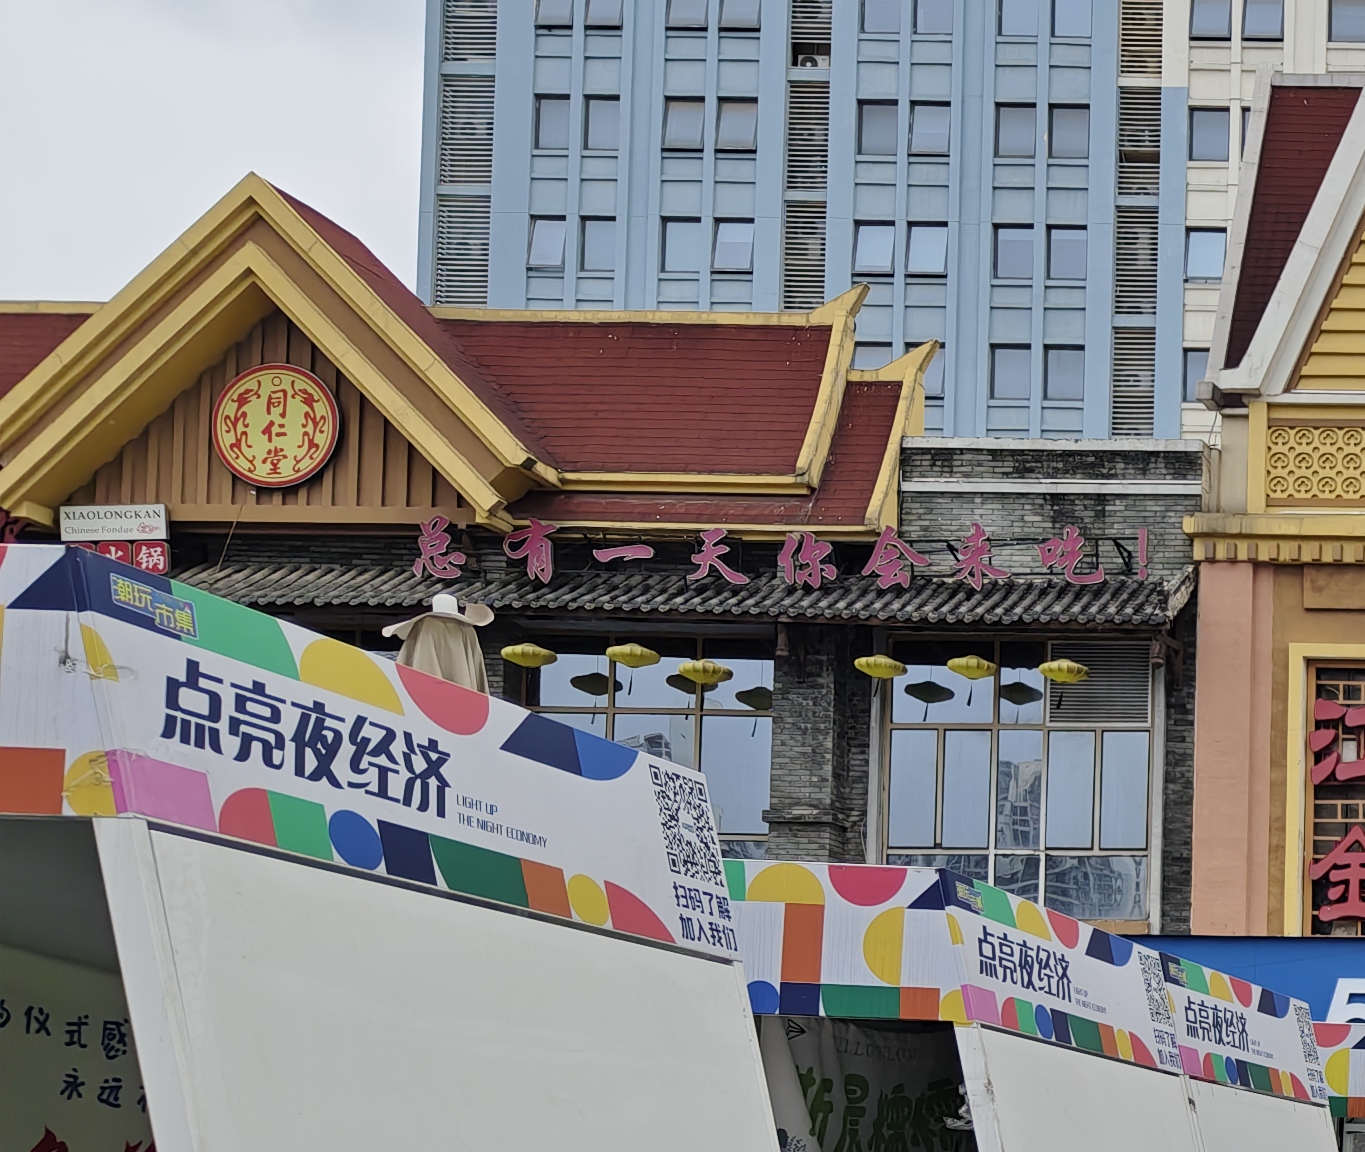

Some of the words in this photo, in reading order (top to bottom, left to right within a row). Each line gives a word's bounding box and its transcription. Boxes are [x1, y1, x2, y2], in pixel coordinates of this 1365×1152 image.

[261, 388, 288, 475] 同仁堂
[63, 508, 161, 521] XIAOLONGKAN
[64, 524, 100, 535] Chinese
[101, 524, 134, 535] Fondue
[112, 577, 196, 634] 潮玩市集
[161, 658, 452, 819] 点亮夜经济
[456, 792, 483, 812] LIGHT
[485, 802, 498, 815] UP
[457, 811, 475, 828] THE
[476, 817, 503, 836] NIGHT
[506, 826, 547, 848] ECONOMY
[673, 880, 732, 922] 扫码了解
[679, 912, 738, 953] 加入我们
[977, 924, 1072, 1004] 点亮夜经济
[1184, 995, 1250, 1053] 点亮夜经济
